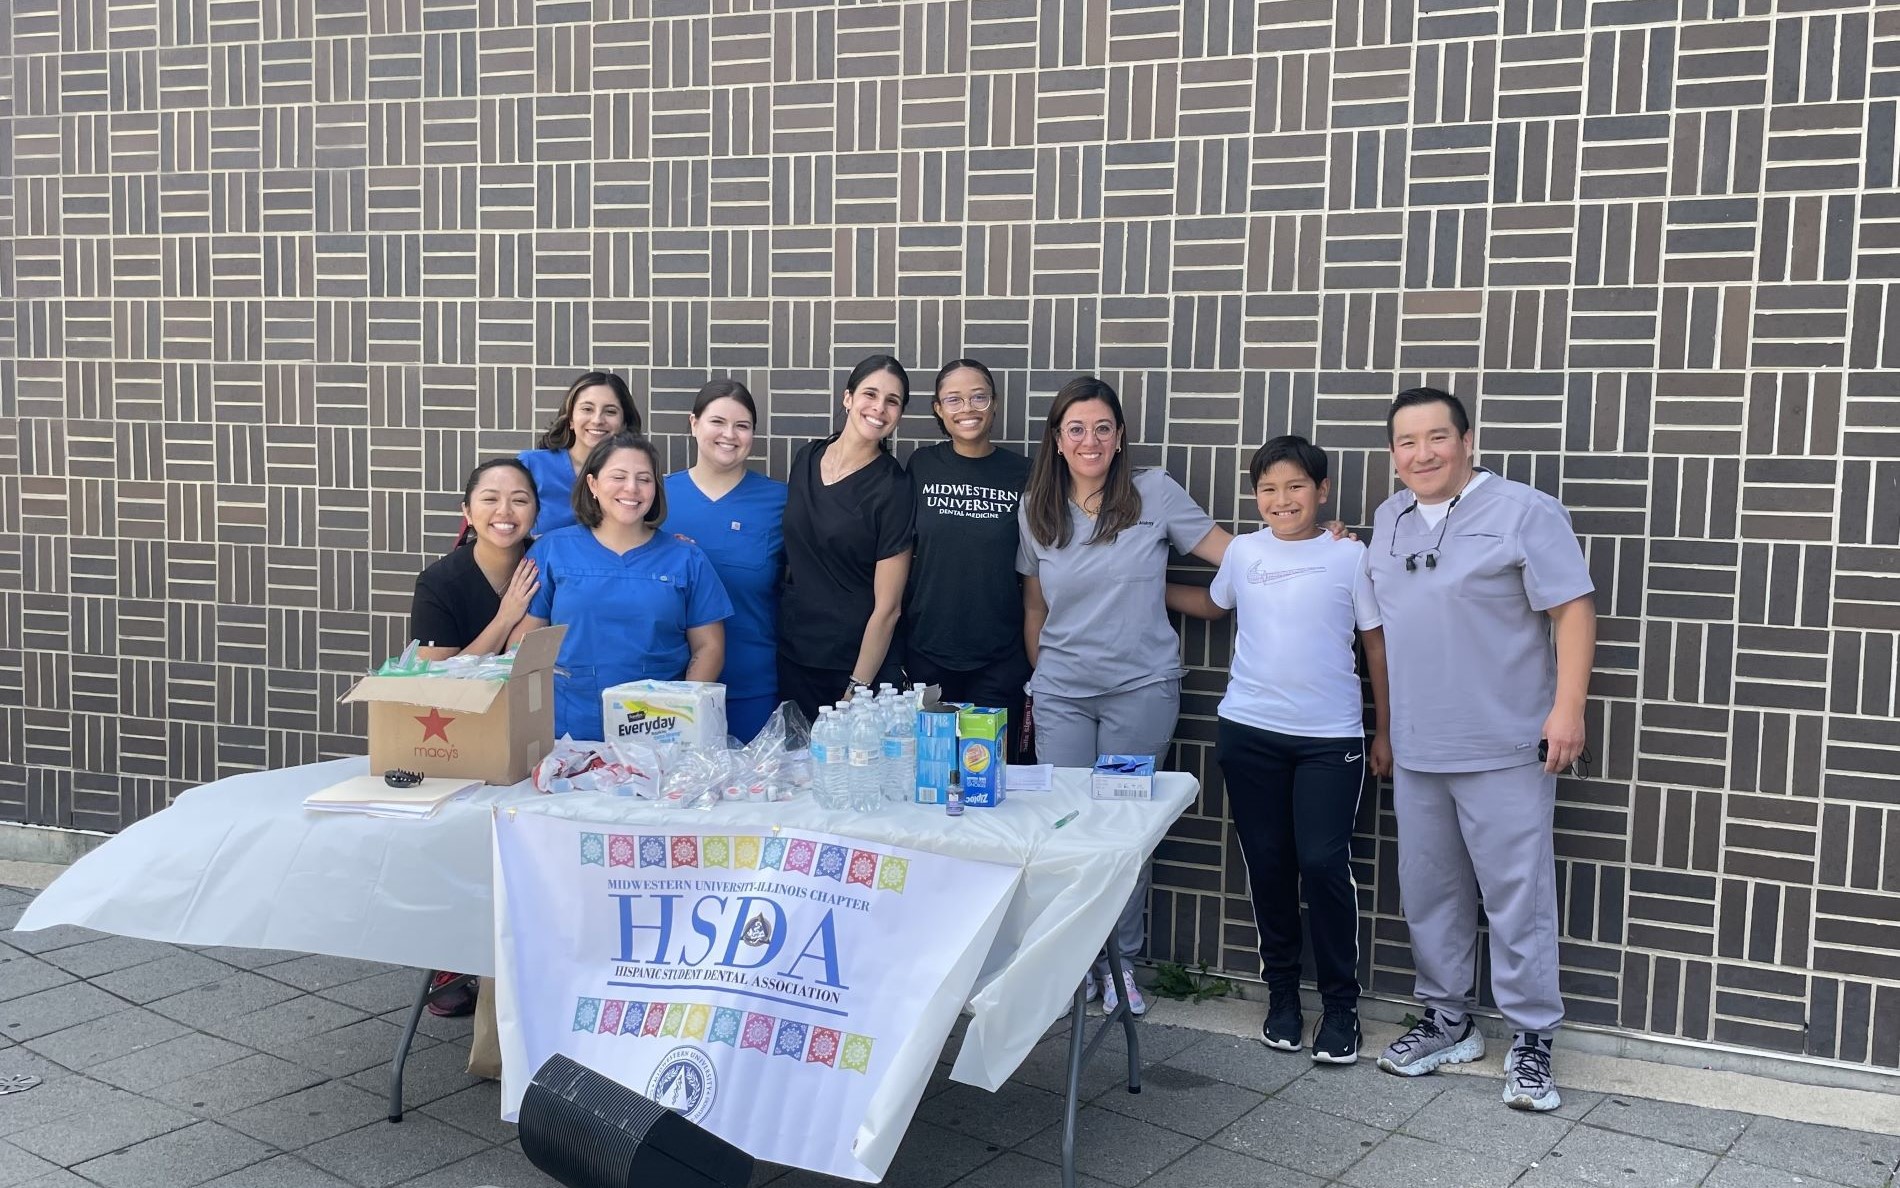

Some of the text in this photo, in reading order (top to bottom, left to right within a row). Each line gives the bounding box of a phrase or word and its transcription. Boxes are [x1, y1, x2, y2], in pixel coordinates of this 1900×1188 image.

[922, 483, 1018, 501] MIDWESTERN
[927, 496, 1013, 512] UNIVERSITY
[939, 508, 964, 517] DENTAL
[618, 716, 676, 737] Everyday
[414, 744, 459, 762] macy's
[965, 792, 989, 804] Ziploc
[607, 879, 870, 912] MIDWESTERN UNIVERSITY-ILLINOIS CHAPTER
[608, 894, 849, 990] HSDA
[615, 965, 841, 1004] HISPANIC STUDENT DENTAL ASSOCIATION
[653, 1050, 713, 1092] MIDWESTERN UNIVERSITY
